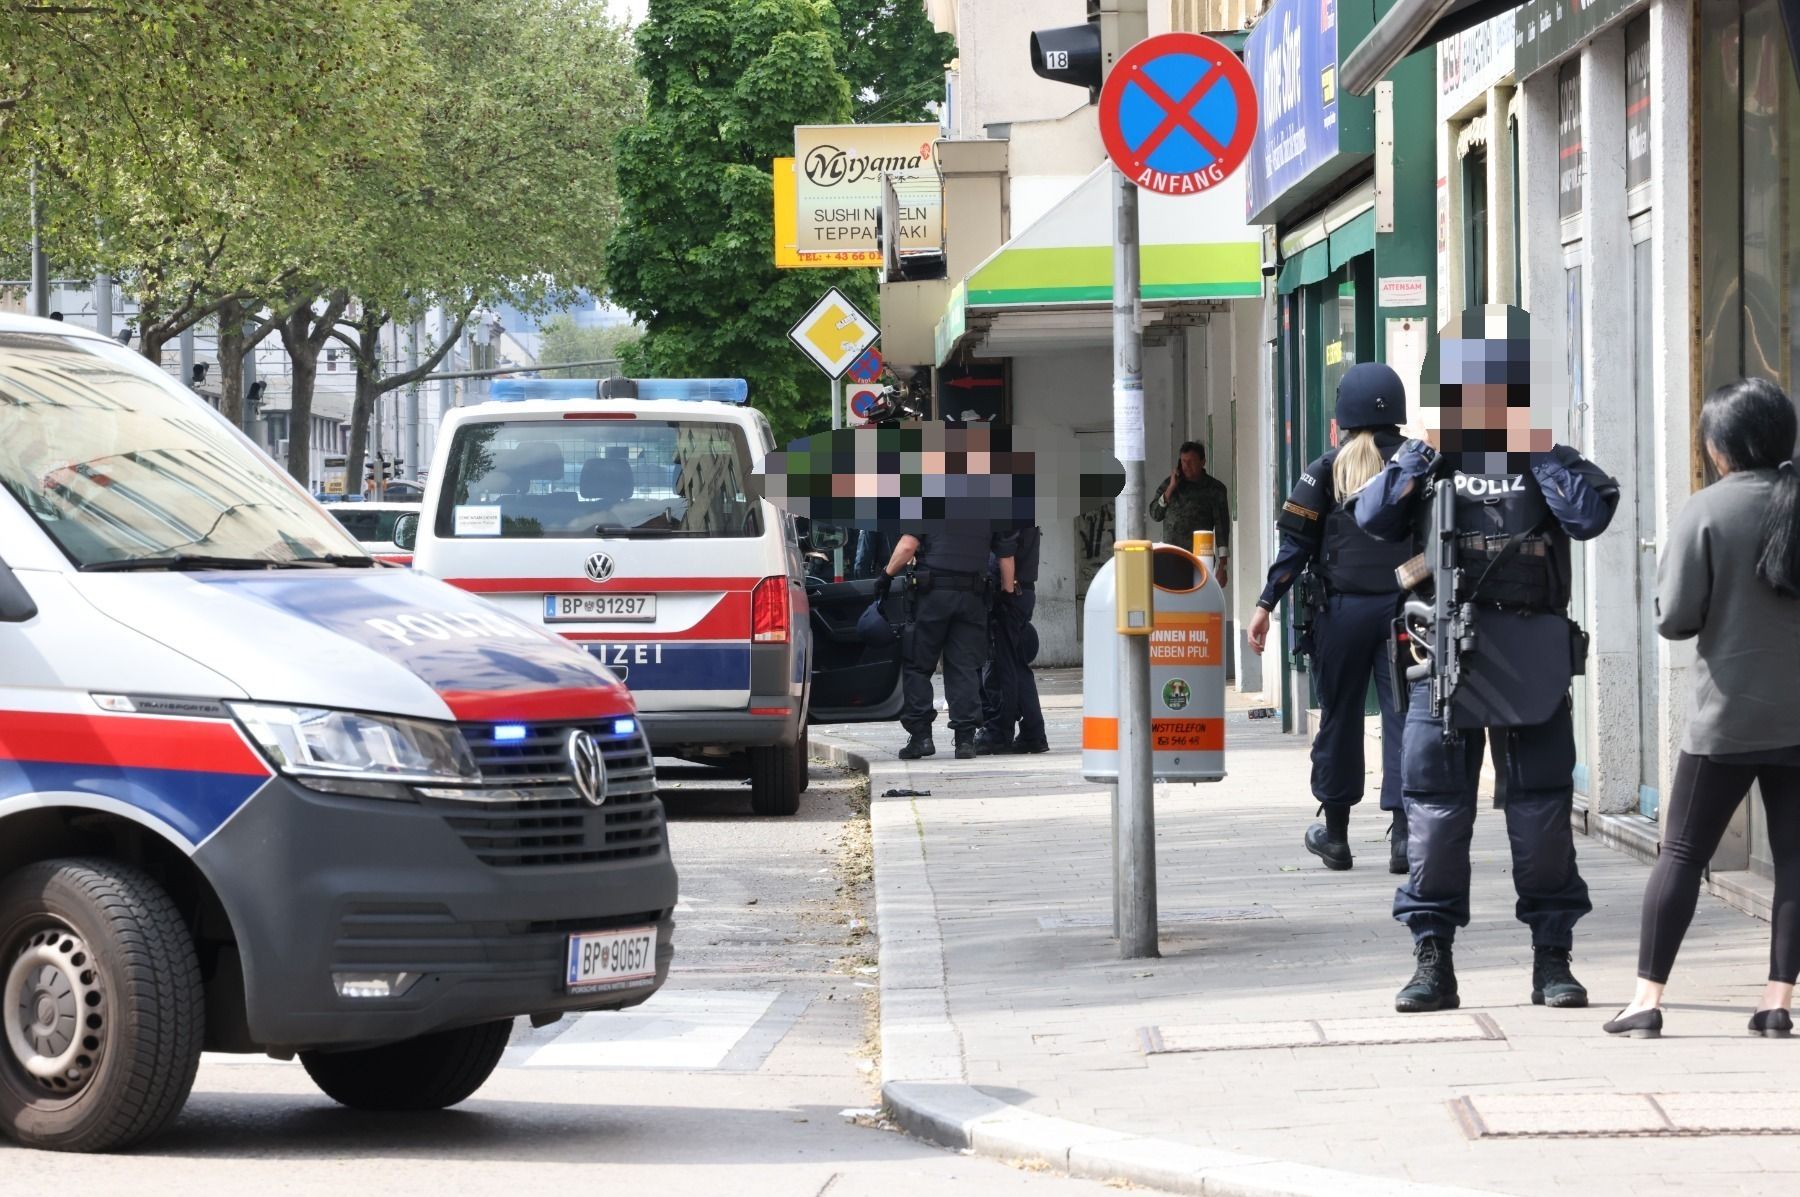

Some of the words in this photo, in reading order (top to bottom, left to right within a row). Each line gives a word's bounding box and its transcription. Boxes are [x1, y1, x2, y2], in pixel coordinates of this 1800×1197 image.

[1048, 53, 1067, 68] 18
[805, 145, 922, 187] Miyama
[1138, 163, 1225, 193] ANFANG
[814, 208, 860, 222] SUSHI
[864, 207, 927, 221] NELN
[814, 225, 927, 240] TEPPAAKI
[798, 252, 822, 261] TEL:
[835, 252, 848, 260] 43
[852, 252, 865, 260] 66
[1383, 283, 1422, 291] ATTENSAM
[562, 598, 583, 614] BP
[596, 598, 646, 614] 91297
[1189, 630, 1209, 644] HUI,
[139, 701, 219, 713] TRANSPORTER
[583, 942, 601, 975] BP
[611, 936, 650, 972] 90657
